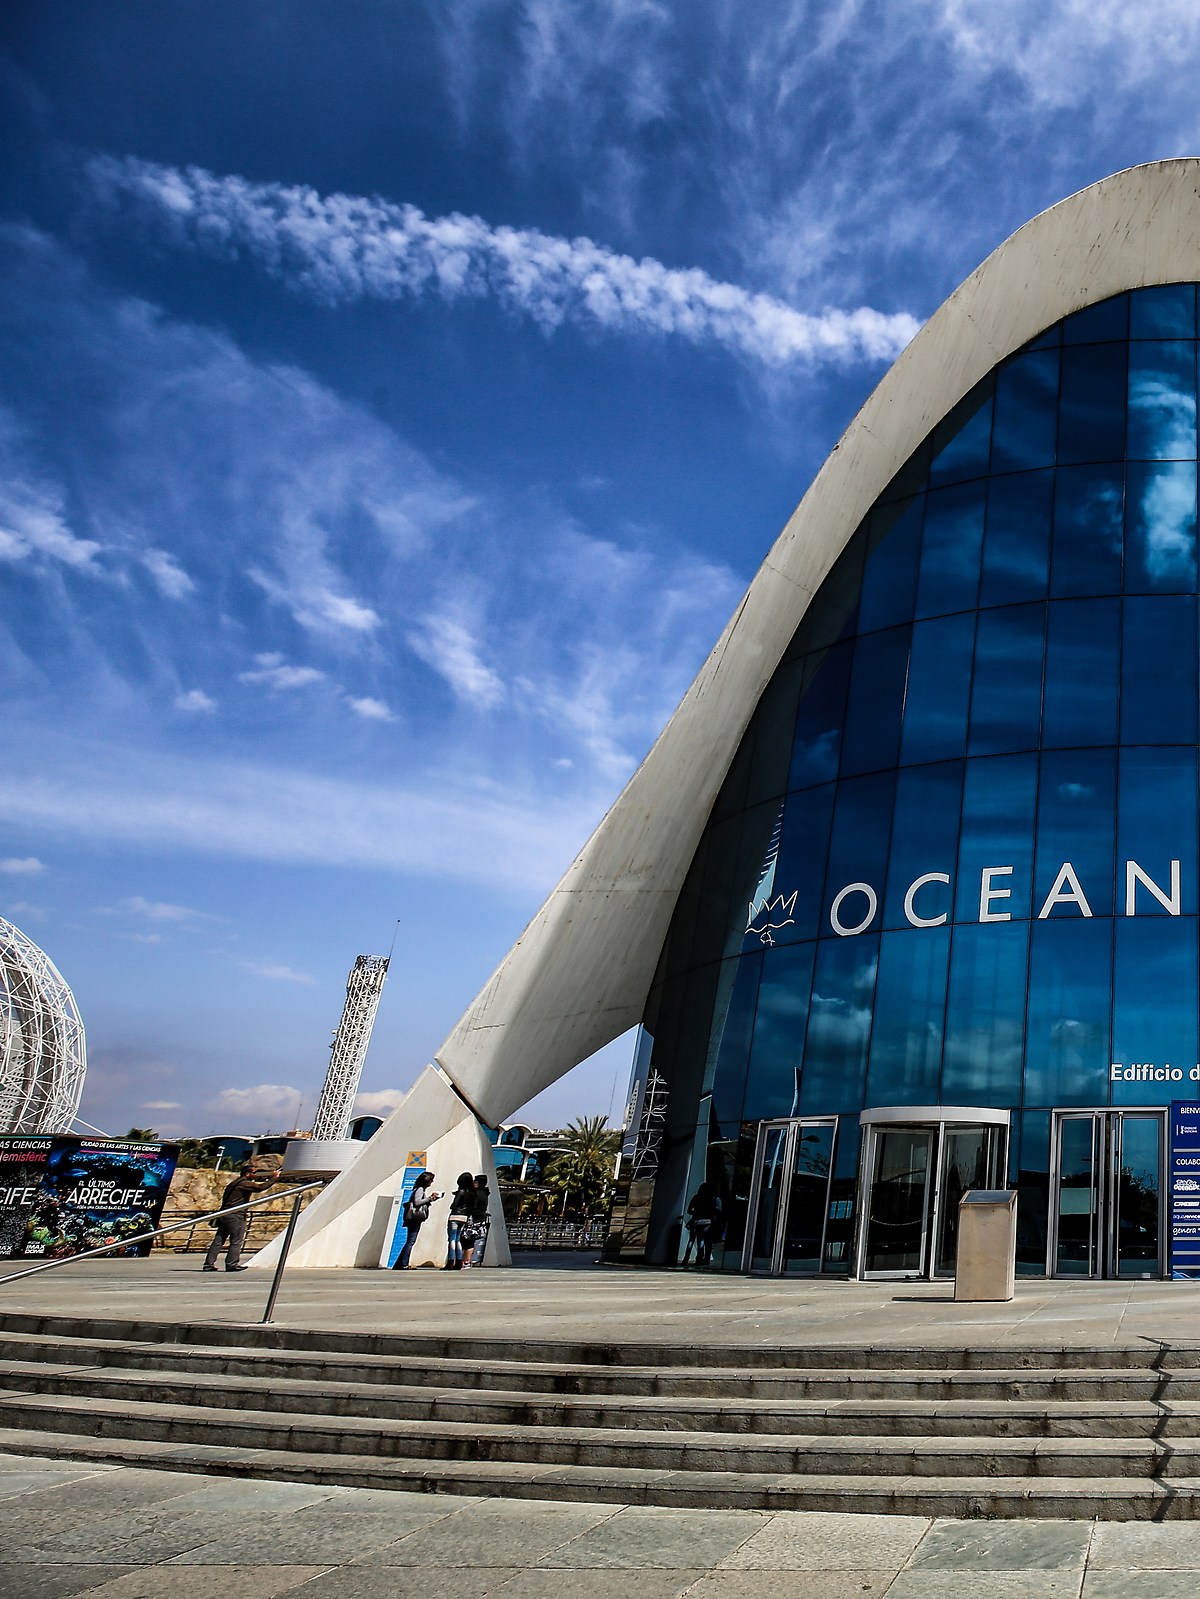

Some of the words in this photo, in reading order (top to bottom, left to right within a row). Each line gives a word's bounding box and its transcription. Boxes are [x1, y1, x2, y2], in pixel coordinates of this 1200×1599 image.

[1110, 1064, 1183, 1081] Edificio
[12, 1141, 52, 1149] CIENCIAS
[87, 1177, 116, 1188] ÚLTIMO
[65, 1187, 146, 1206] ARRECIFE
